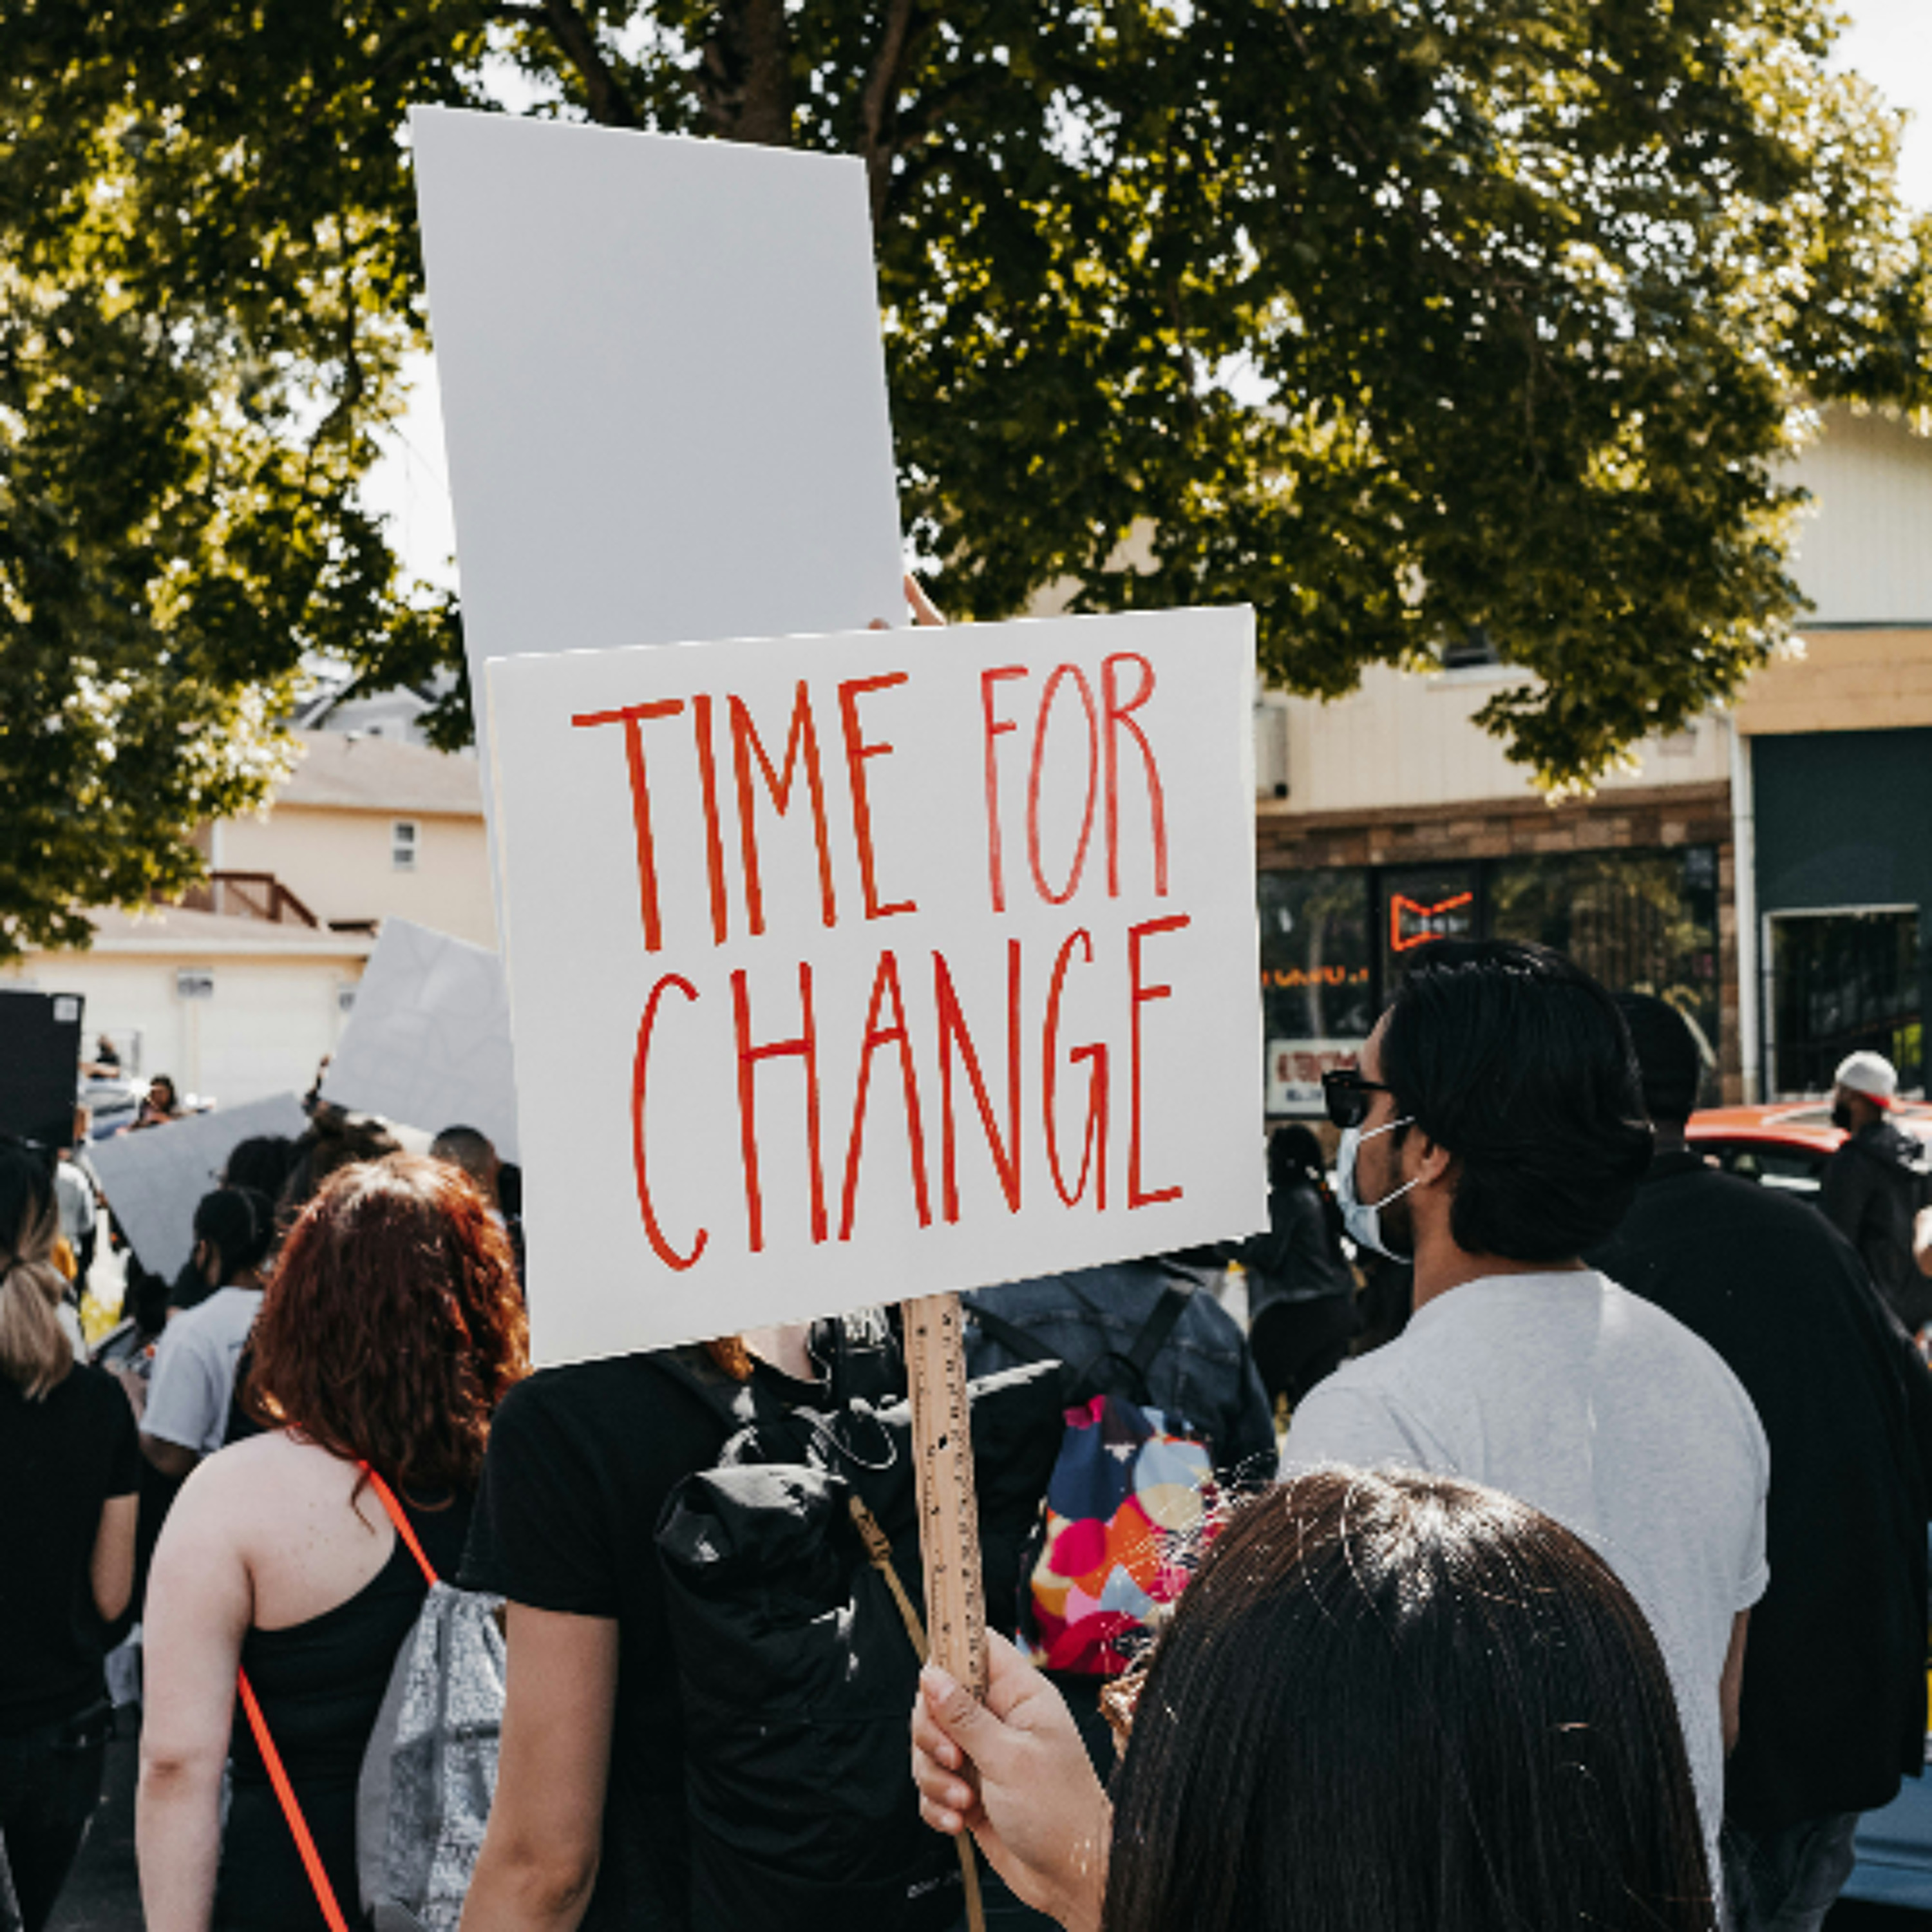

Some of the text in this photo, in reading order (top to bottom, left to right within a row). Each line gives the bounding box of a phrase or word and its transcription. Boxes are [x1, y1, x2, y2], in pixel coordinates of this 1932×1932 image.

[572, 652, 1167, 952] TIME FOR
[632, 914, 1191, 1271] CHANGE
